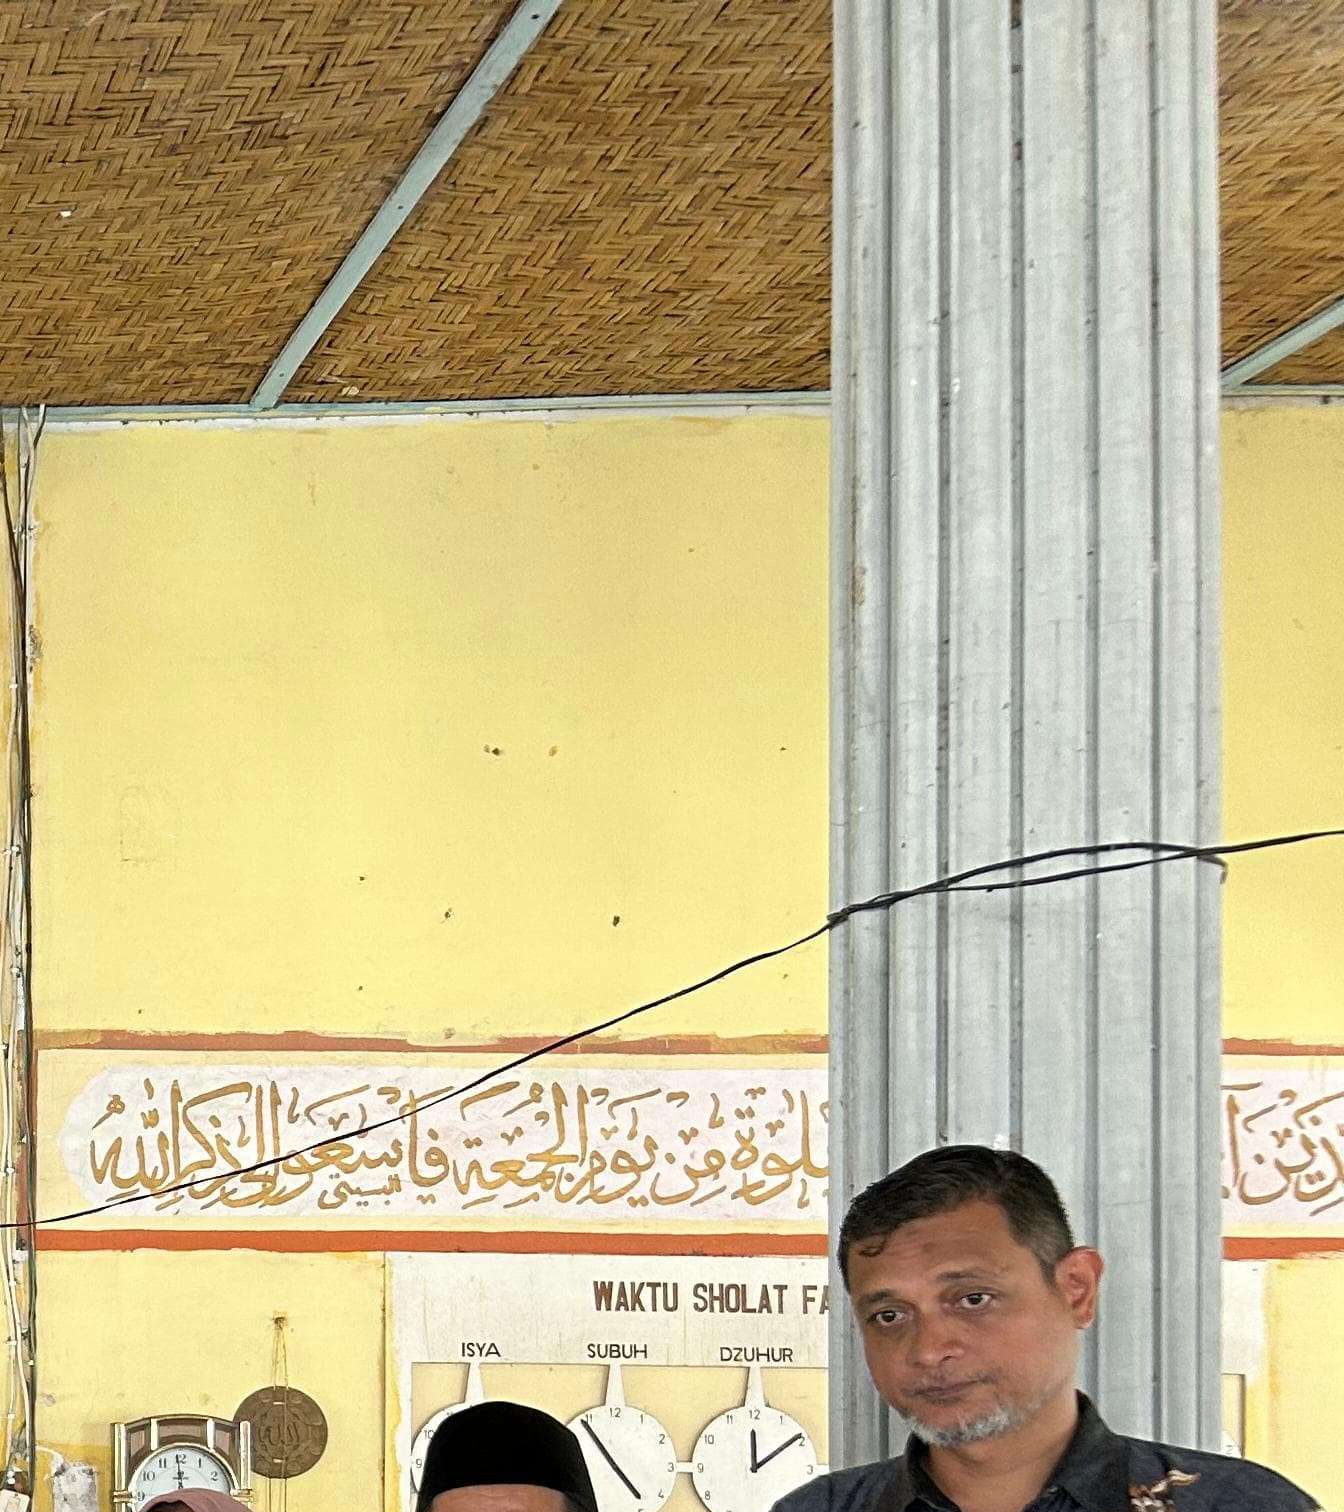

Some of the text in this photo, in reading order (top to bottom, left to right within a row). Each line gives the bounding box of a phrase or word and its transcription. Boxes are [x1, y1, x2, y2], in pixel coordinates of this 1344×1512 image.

[593, 1281, 679, 1314] WAKTU
[692, 1283, 788, 1315] SHOLAT
[461, 1342, 501, 1357] ISYA
[587, 1343, 648, 1359] SUBUH
[719, 1346, 794, 1363] DZUHUR
